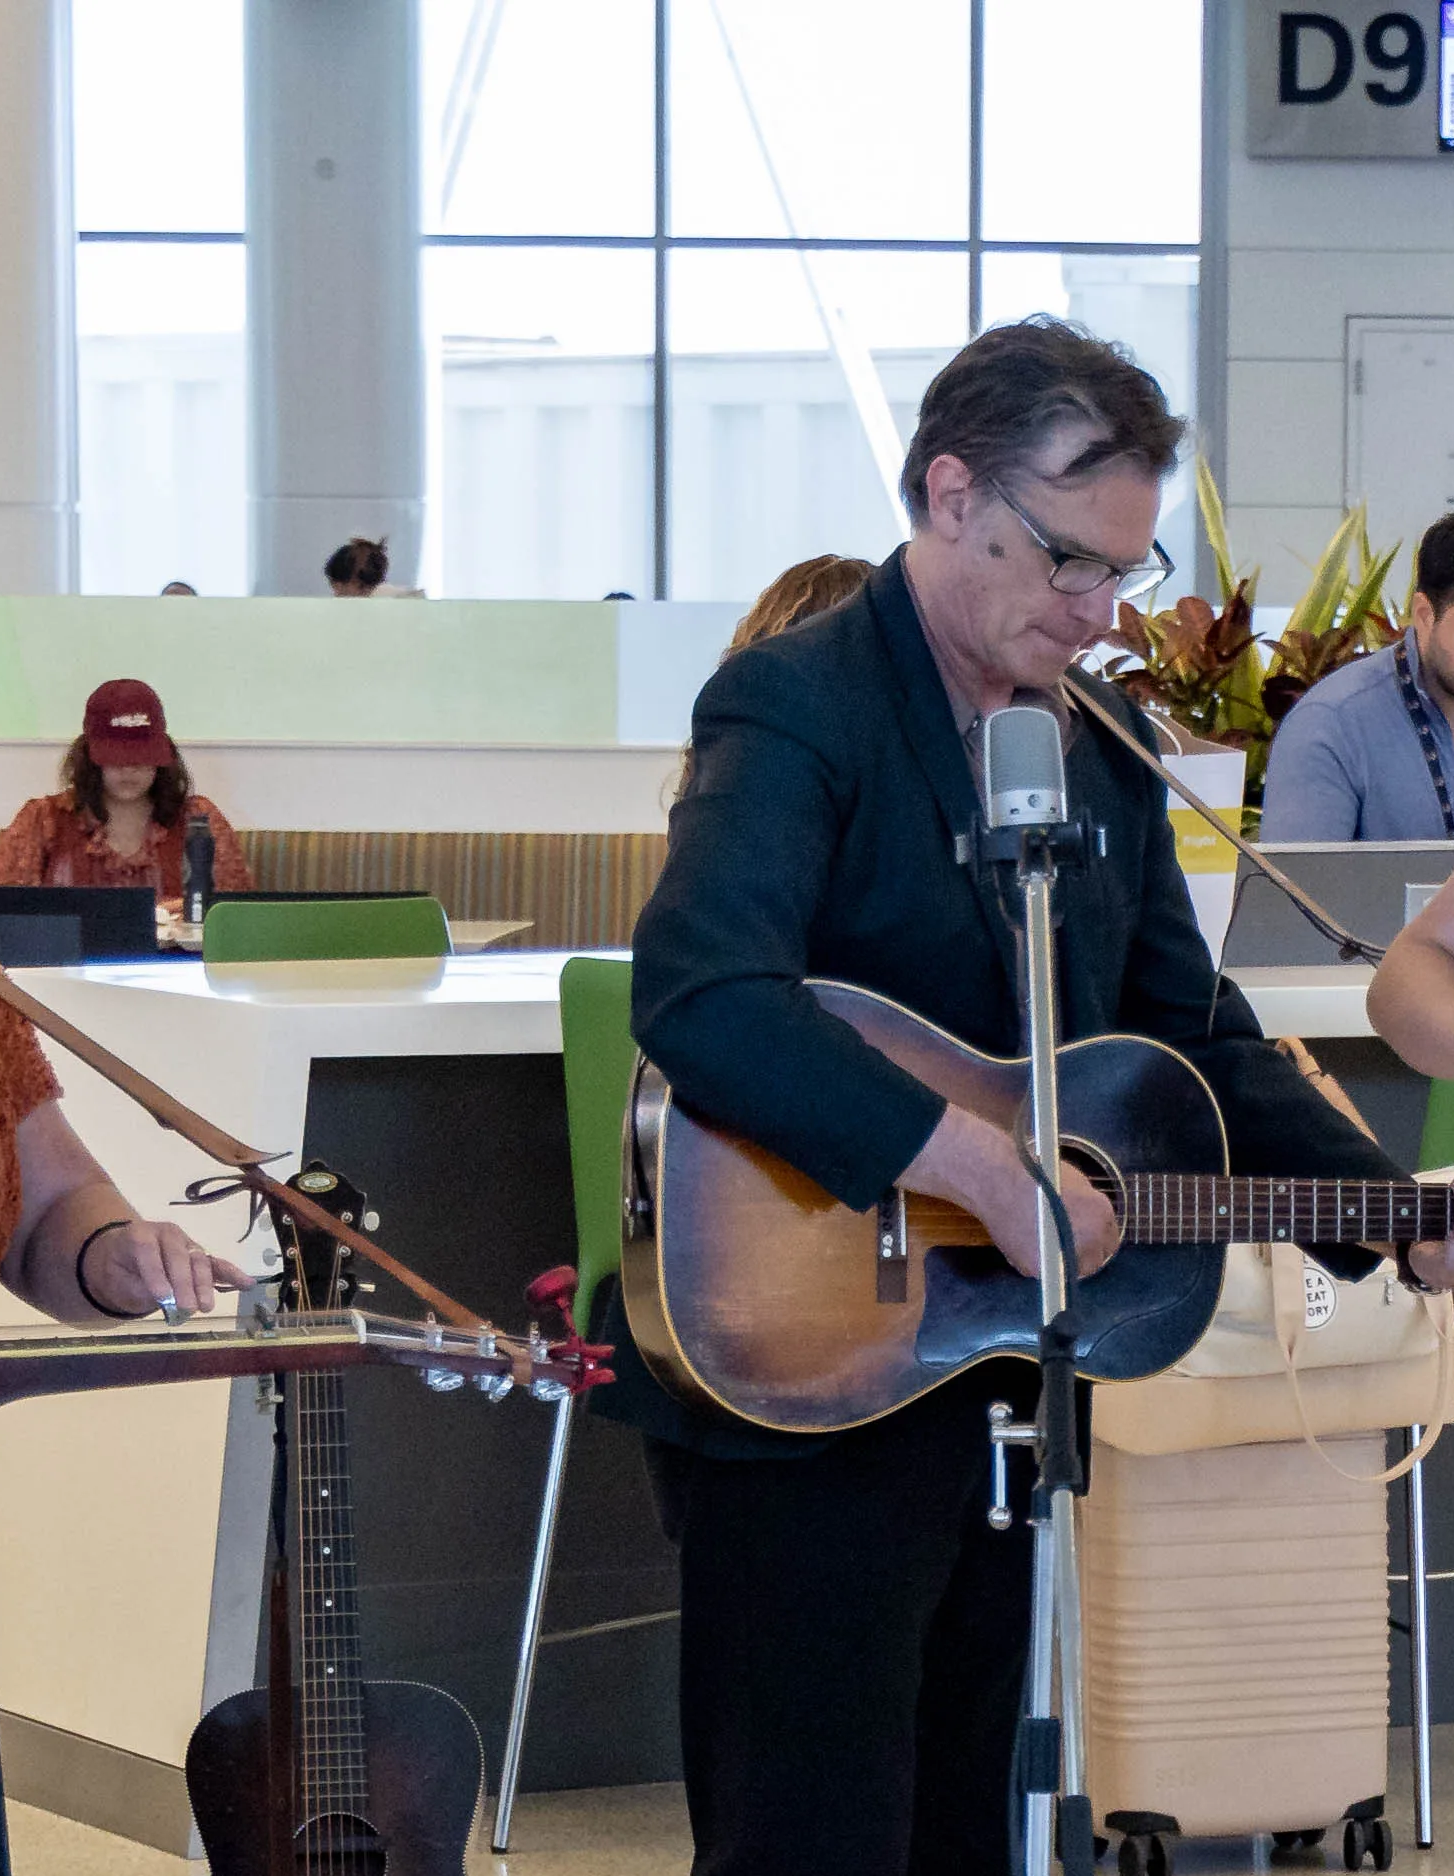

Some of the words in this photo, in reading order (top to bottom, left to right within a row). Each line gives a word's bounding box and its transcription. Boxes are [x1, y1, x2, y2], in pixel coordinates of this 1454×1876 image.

[1279, 13, 1428, 106] D9
[1317, 1277, 1324, 1286] A
[1306, 1291, 1327, 1303] EAT
[1306, 1305, 1329, 1317] ORY
